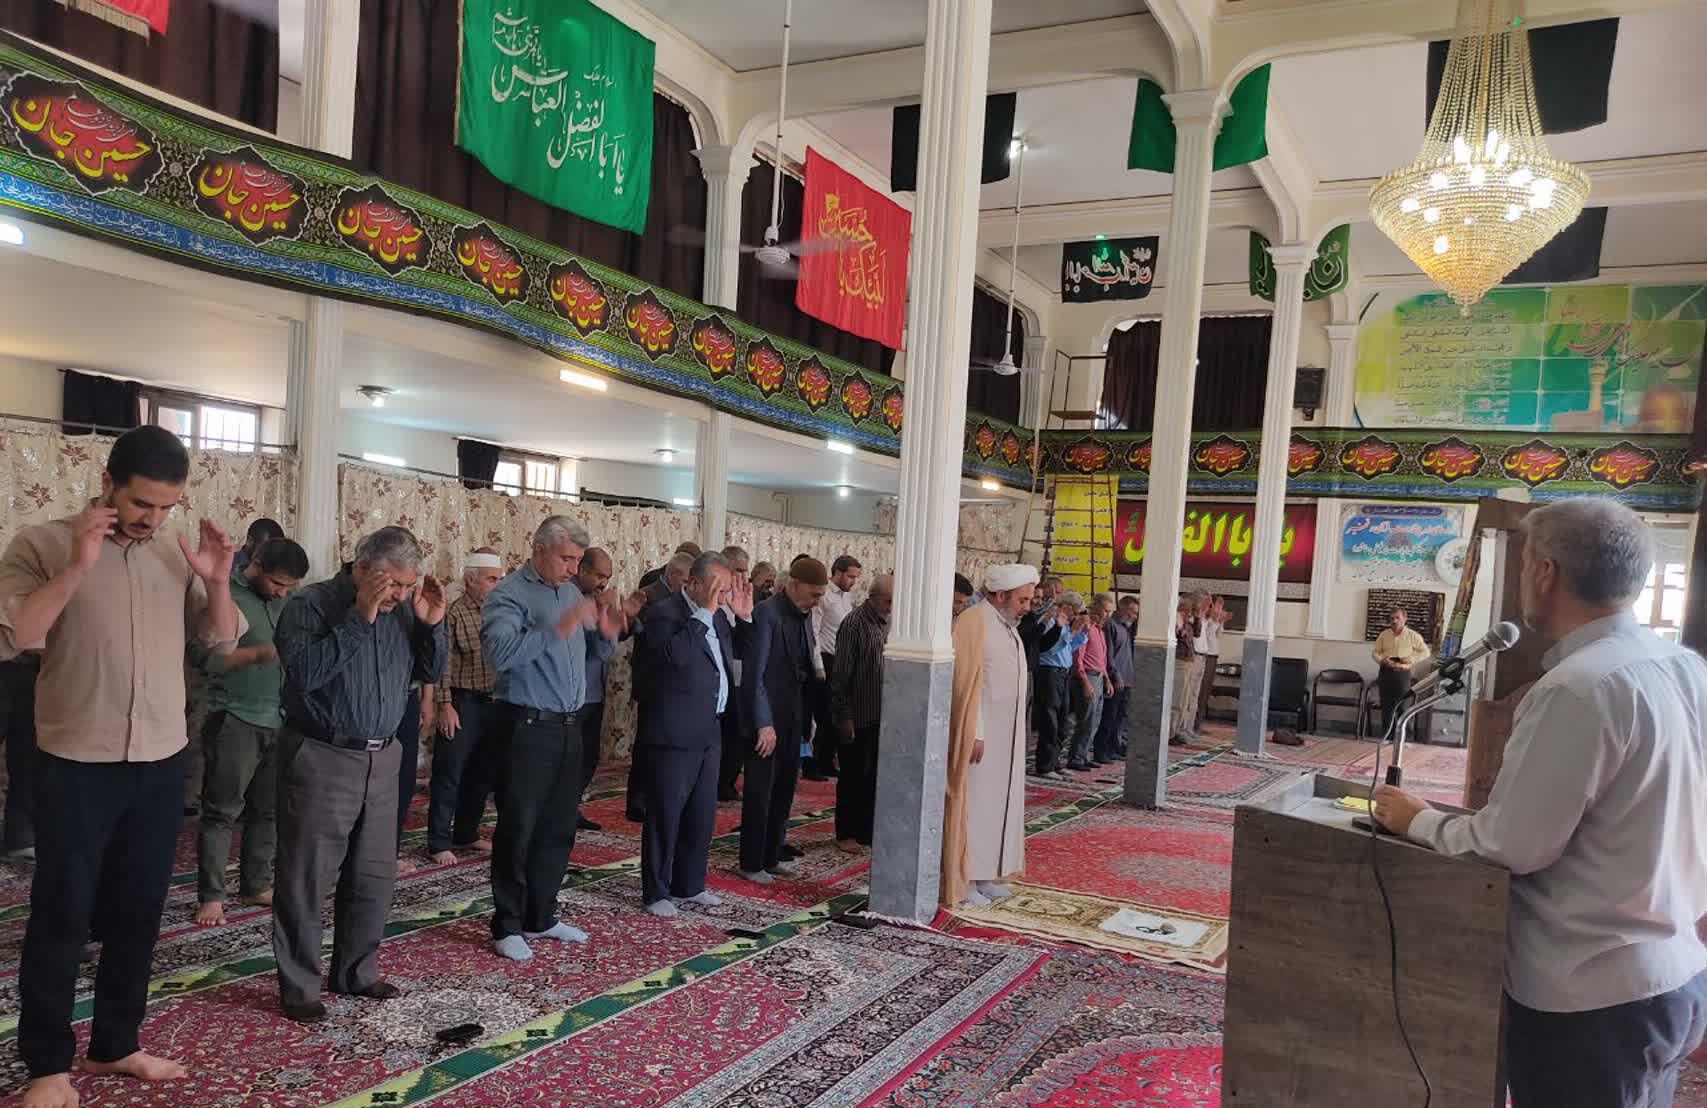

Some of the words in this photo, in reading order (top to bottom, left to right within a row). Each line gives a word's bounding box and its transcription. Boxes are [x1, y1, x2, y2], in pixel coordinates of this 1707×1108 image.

[491, 64, 569, 128] العباس
[12, 97, 77, 159] جان
[74, 140, 151, 182] حسین
[199, 166, 249, 220] جان
[240, 193, 300, 232] حسین
[337, 207, 382, 251] جان
[379, 226, 424, 263] حسین
[457, 241, 492, 284] جان
[491, 265, 524, 295] حسین
[551, 279, 577, 318] جان
[576, 296, 606, 328] حسین
[1215, 449, 1247, 472] حسین
[1342, 449, 1367, 472] جان
[1363, 450, 1399, 474] حسین
[1422, 452, 1446, 475] جان
[1445, 453, 1480, 478] حسین
[1504, 452, 1532, 477] جان
[1528, 456, 1566, 481] حسین
[1590, 455, 1618, 480] جان
[1615, 459, 1655, 484] حسین
